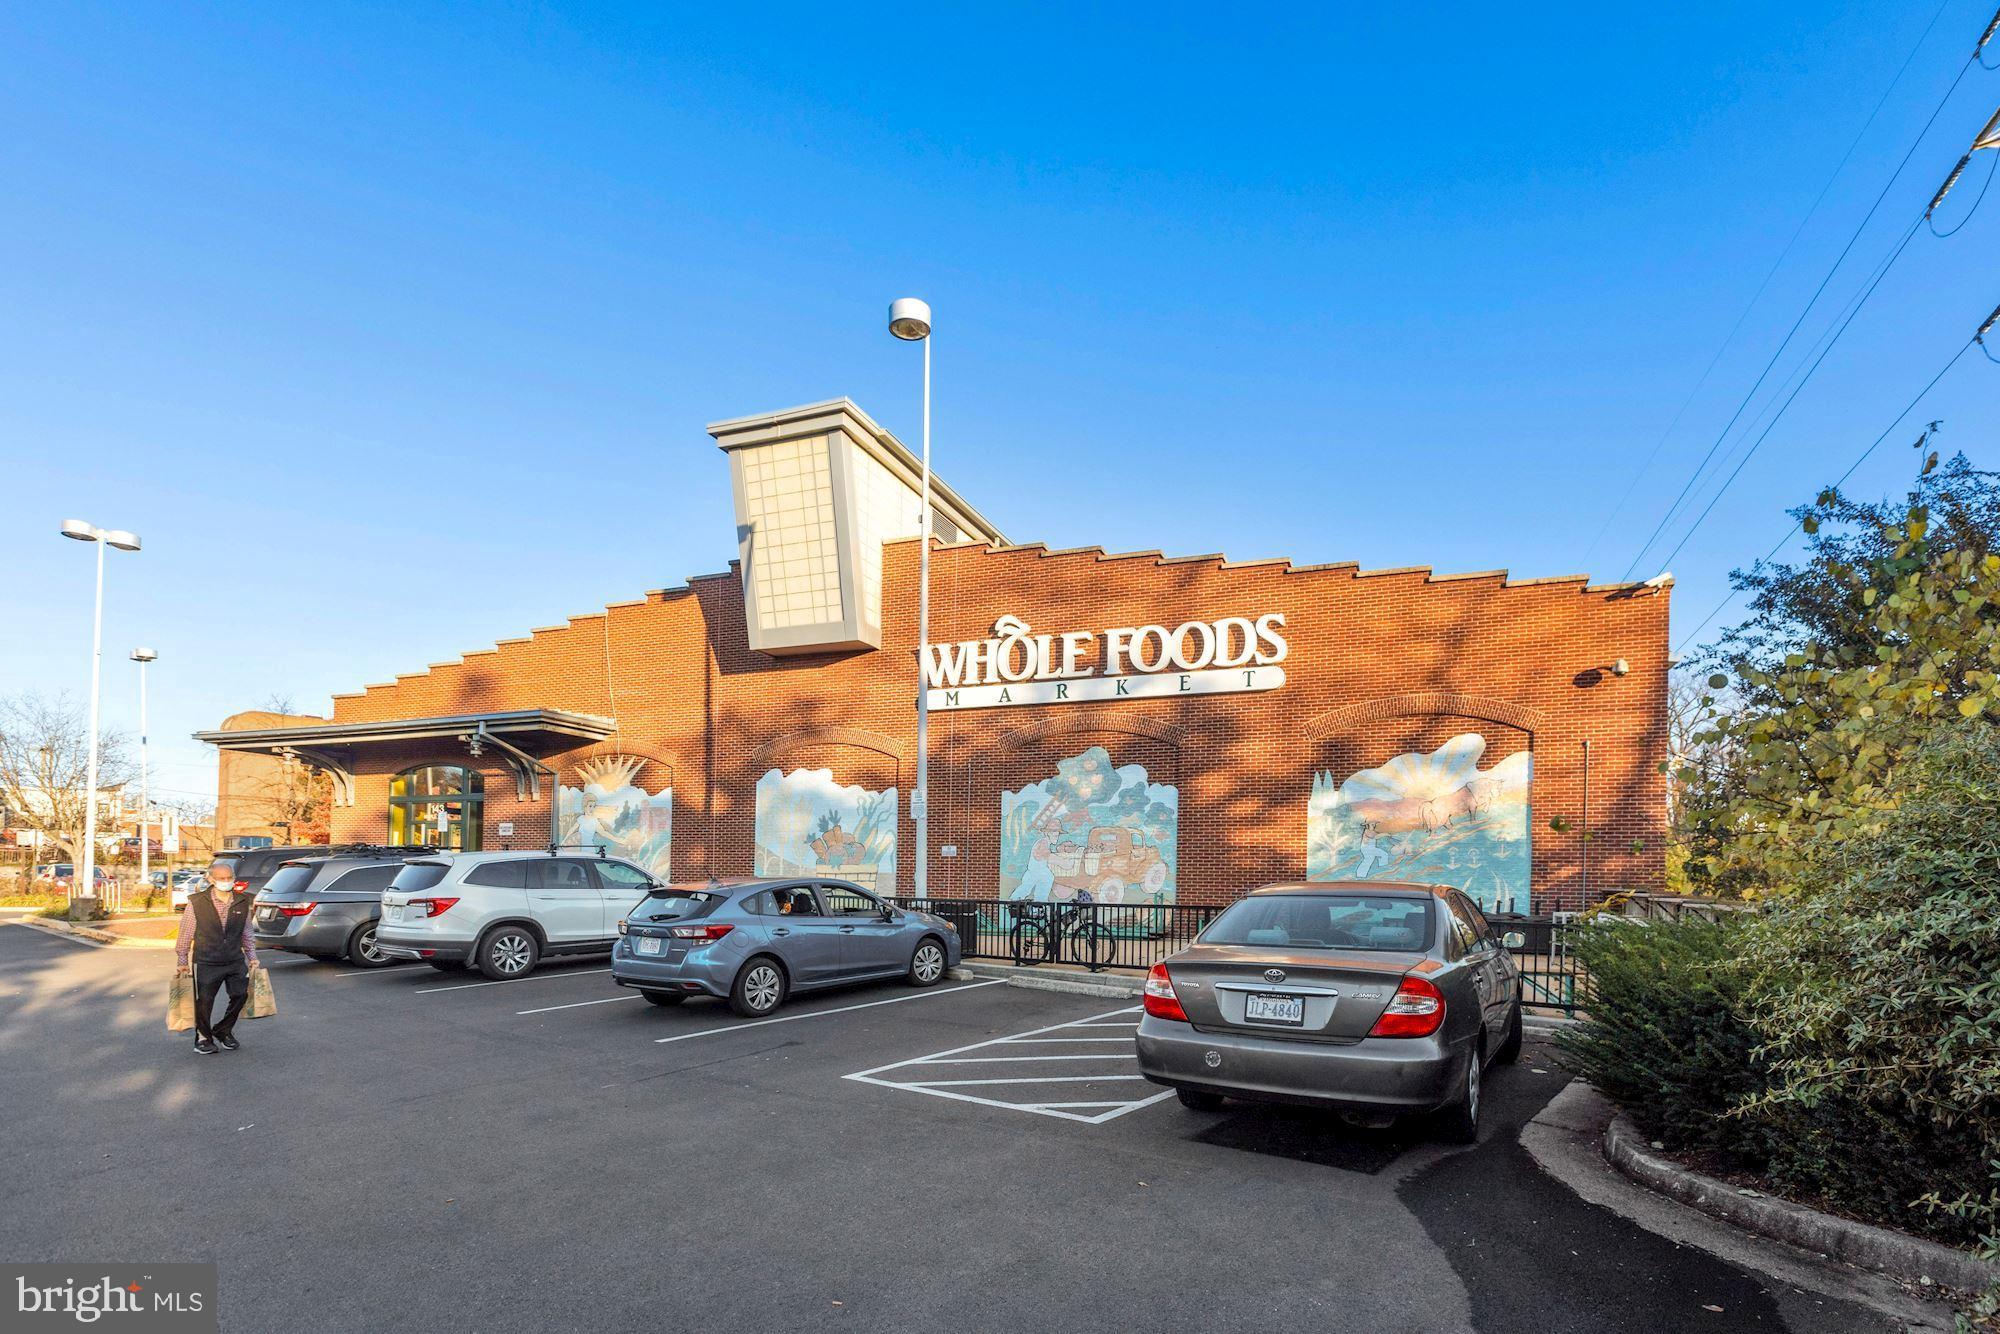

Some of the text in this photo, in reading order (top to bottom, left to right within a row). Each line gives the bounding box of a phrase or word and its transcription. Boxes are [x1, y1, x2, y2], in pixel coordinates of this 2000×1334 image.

[918, 612, 1288, 689] WHOLE FOODS
[945, 670, 1256, 706] MARKET
